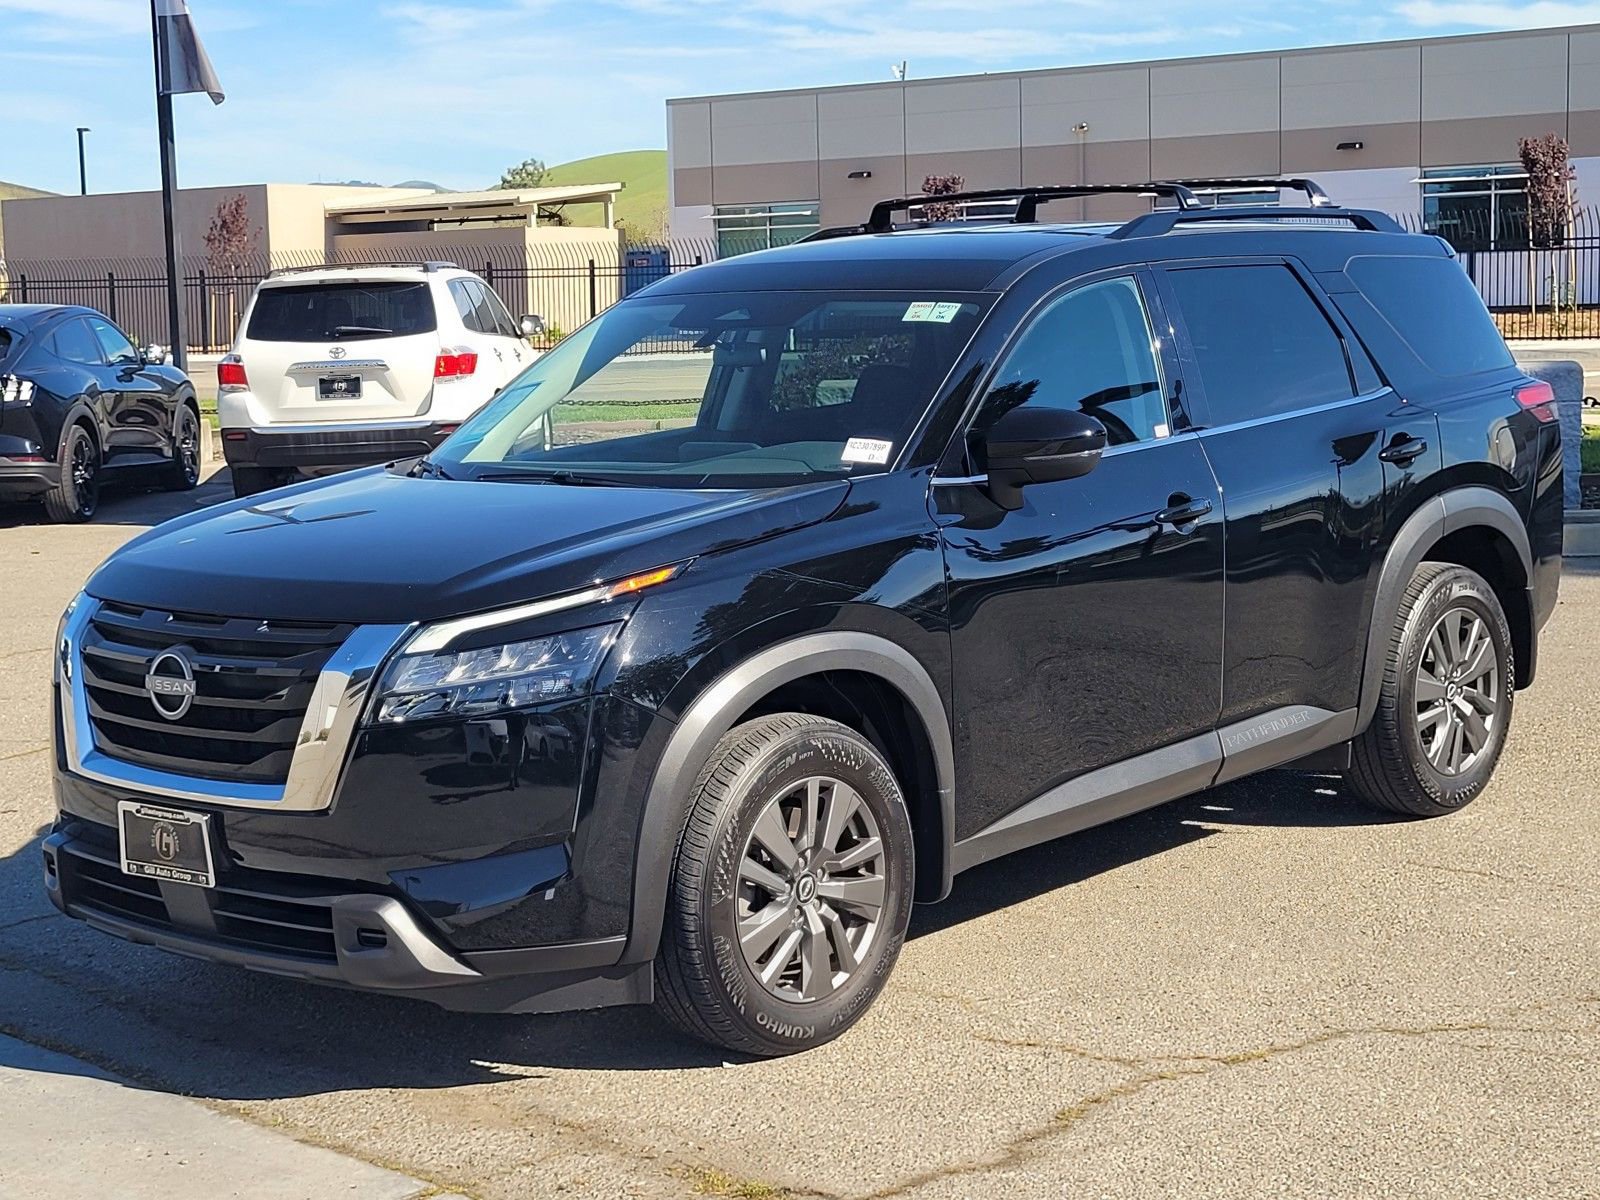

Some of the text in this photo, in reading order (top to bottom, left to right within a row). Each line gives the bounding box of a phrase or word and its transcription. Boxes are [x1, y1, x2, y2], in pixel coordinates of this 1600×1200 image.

[1225, 710, 1311, 748] PATHFINDER
[798, 750, 814, 761] HP71
[144, 865, 156, 875] Gill
[156, 867, 171, 878] Auto
[172, 869, 192, 882] Group
[756, 1012, 815, 1039] KUMHO
